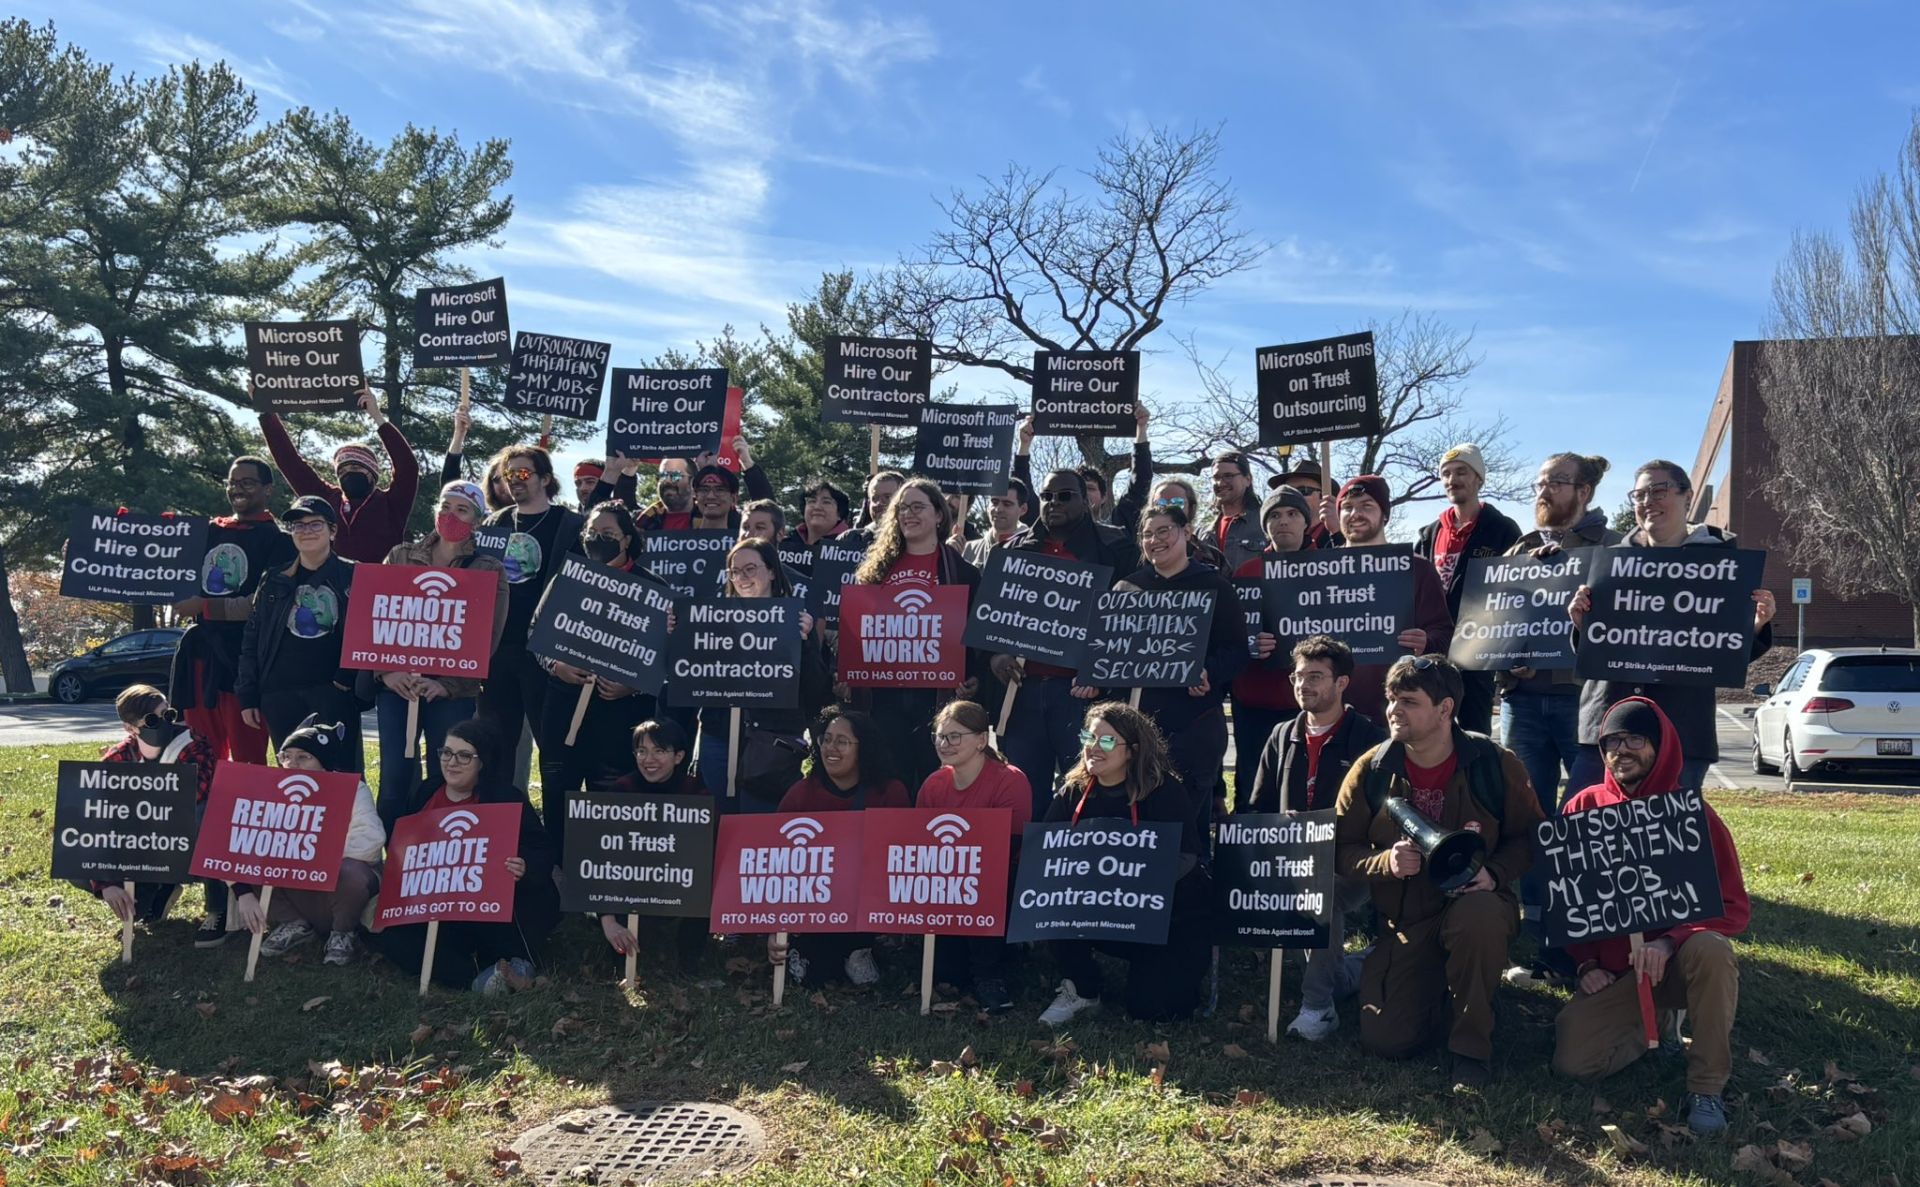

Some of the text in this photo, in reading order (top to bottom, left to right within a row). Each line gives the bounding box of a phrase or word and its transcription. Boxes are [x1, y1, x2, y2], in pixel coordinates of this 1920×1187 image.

[430, 286, 497, 306] Microsoft
[435, 310, 495, 326] Hire Our
[258, 327, 343, 344] Microsoft
[419, 330, 507, 347] Contractors
[266, 350, 340, 366] Hire Our
[519, 334, 607, 364] OUTSOURCING
[840, 342, 917, 360] Microsoft
[1258, 342, 1372, 370] Microsoft Runs
[520, 354, 598, 379] THREATENS
[844, 364, 912, 381] Hire Our
[1048, 356, 1125, 371] Microsoft
[255, 373, 359, 389] Contractors
[527, 373, 584, 394] MY JOB
[628, 374, 712, 390] Microsoft
[1051, 378, 1119, 392] Hire Our
[1289, 369, 1351, 392] on Trust
[516, 389, 589, 416] SECURITY
[632, 397, 706, 413] Hire Our
[828, 384, 925, 404] Contractors
[921, 408, 1015, 426] Microsoft Runs
[1035, 398, 1133, 414] Contractors
[1273, 394, 1366, 419] Outsourcing
[613, 418, 718, 435] Contractors
[943, 433, 994, 449] on Trust
[717, 457, 731, 465] GO
[926, 453, 1002, 474] Outsourcing
[92, 514, 192, 536] Microsoft
[94, 537, 182, 558] Hire Our
[646, 536, 735, 553] Microsoft
[71, 557, 196, 581] Contractors
[651, 559, 687, 574] Hire
[1002, 556, 1094, 588] Microsoft
[1265, 555, 1355, 580] Microsoft
[1361, 554, 1410, 573] Runs
[1484, 556, 1582, 583] Microsoft
[1611, 556, 1738, 580] Microsoft
[561, 559, 643, 601] Microsoft
[1000, 581, 1081, 612] Hire Our
[1098, 589, 1212, 614] OUTSOURCING
[1298, 583, 1375, 606] on Trust
[1484, 587, 1572, 612] Hire Our
[1614, 589, 1725, 614] Hire Our
[372, 592, 467, 625] REMOTE
[580, 597, 650, 633] on Trust
[690, 605, 785, 623] Microsoft
[861, 614, 942, 638] REMOTE
[976, 604, 1087, 641] Contractors
[1100, 613, 1197, 636] THREATENS
[1279, 612, 1395, 638] Outsourcing
[1460, 615, 1572, 641] Contractor
[373, 619, 463, 650] WORKS
[554, 612, 657, 666] Outsourcing
[694, 632, 777, 650] Hire Our
[1587, 622, 1743, 650] Contractors
[862, 639, 940, 663] WORKS
[1106, 637, 1176, 657] MY JOB
[352, 651, 478, 670] RTO HAS GOT TO GO
[675, 659, 793, 678] Contractors
[1092, 658, 1195, 683] SECURITY
[1624, 661, 1646, 670] Strike
[1646, 663, 1675, 672] Against
[1676, 664, 1713, 673] Microsoft
[847, 670, 956, 681] RTO HAS GOT TO GO
[80, 769, 179, 791] Microsoft
[85, 799, 173, 821] Hire Our
[231, 794, 326, 835] REMOTE
[569, 799, 710, 824] Microsoft Runs
[1538, 789, 1702, 846] OUTSOURCING
[61, 827, 189, 851] Contractors
[229, 825, 318, 861] WORKS
[601, 832, 676, 852] on Trust
[1043, 829, 1158, 849] Microsoft
[1219, 821, 1335, 844] Microsoft Runs
[402, 835, 489, 871] REMOTE
[1545, 817, 1701, 875] THREATENS
[203, 858, 328, 882] RTO HAS GOT TO GO
[739, 846, 835, 874] REMOTE
[887, 845, 982, 874] REMOTE
[1044, 856, 1146, 877] Hire Our
[1250, 855, 1314, 877] on Trust
[400, 865, 483, 897] WORKS
[580, 859, 693, 888] Outsourcing
[740, 875, 831, 904] WORKS
[888, 875, 978, 905] WORKS
[1019, 887, 1164, 910] Contractors
[1547, 864, 1663, 914] MY JOB
[382, 901, 500, 919] RTO HAS GOT TO GO
[1229, 888, 1324, 916] Outsourcing
[1567, 881, 1701, 938] SECURITY!
[721, 912, 848, 924] RTO HAS GOT TO GO
[869, 912, 995, 927] RTO HAS GOT TO GO
[1035, 920, 1136, 930] ULP Strike Against Microsoft
